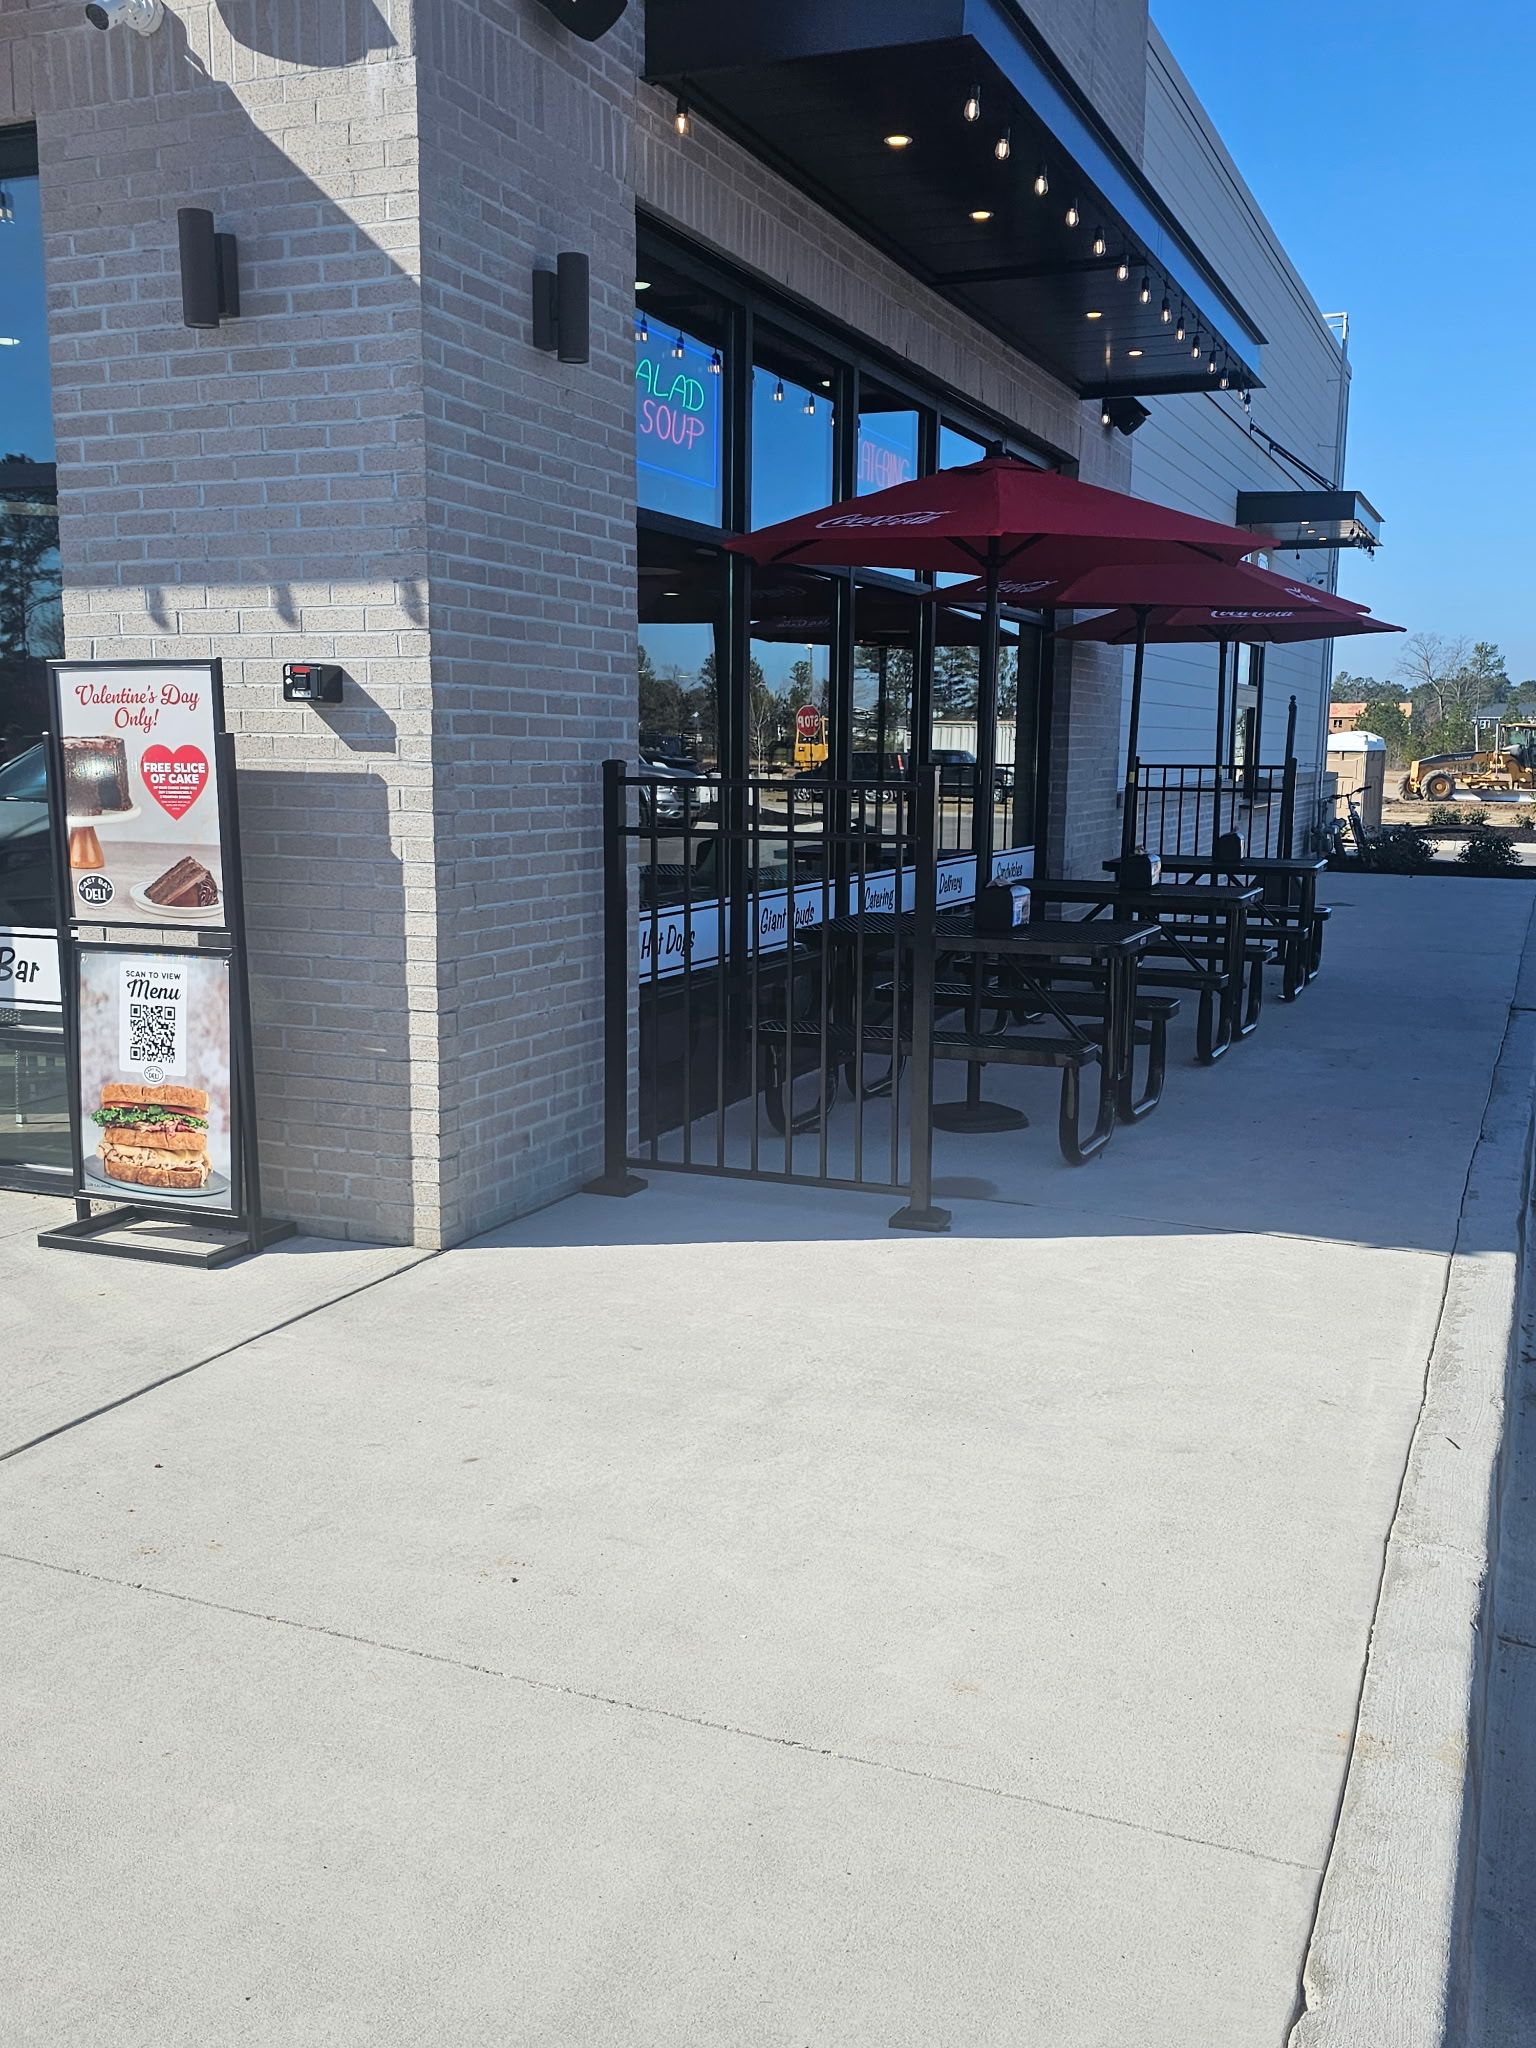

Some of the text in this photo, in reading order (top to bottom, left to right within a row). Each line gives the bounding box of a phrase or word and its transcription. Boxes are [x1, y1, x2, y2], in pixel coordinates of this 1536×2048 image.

[635, 358, 705, 412] ALAD
[640, 399, 705, 450] SOUP
[857, 439, 911, 483] ATERING
[75, 683, 200, 711] Valentine's Day
[115, 705, 160, 733] Only!
[143, 762, 206, 774] FREE SLICE
[150, 773, 200, 785] OF CAKE
[85, 887, 108, 901] DELI
[97, 878, 112, 892] BAY
[939, 872, 962, 895] Delivery
[865, 886, 894, 911] Catering
[760, 900, 815, 935] Giant puds
[640, 927, 664, 960] Ht
[0, 946, 40, 983] Bar
[125, 969, 181, 980] SCAN TO VIEW
[126, 978, 182, 1000] Menu
